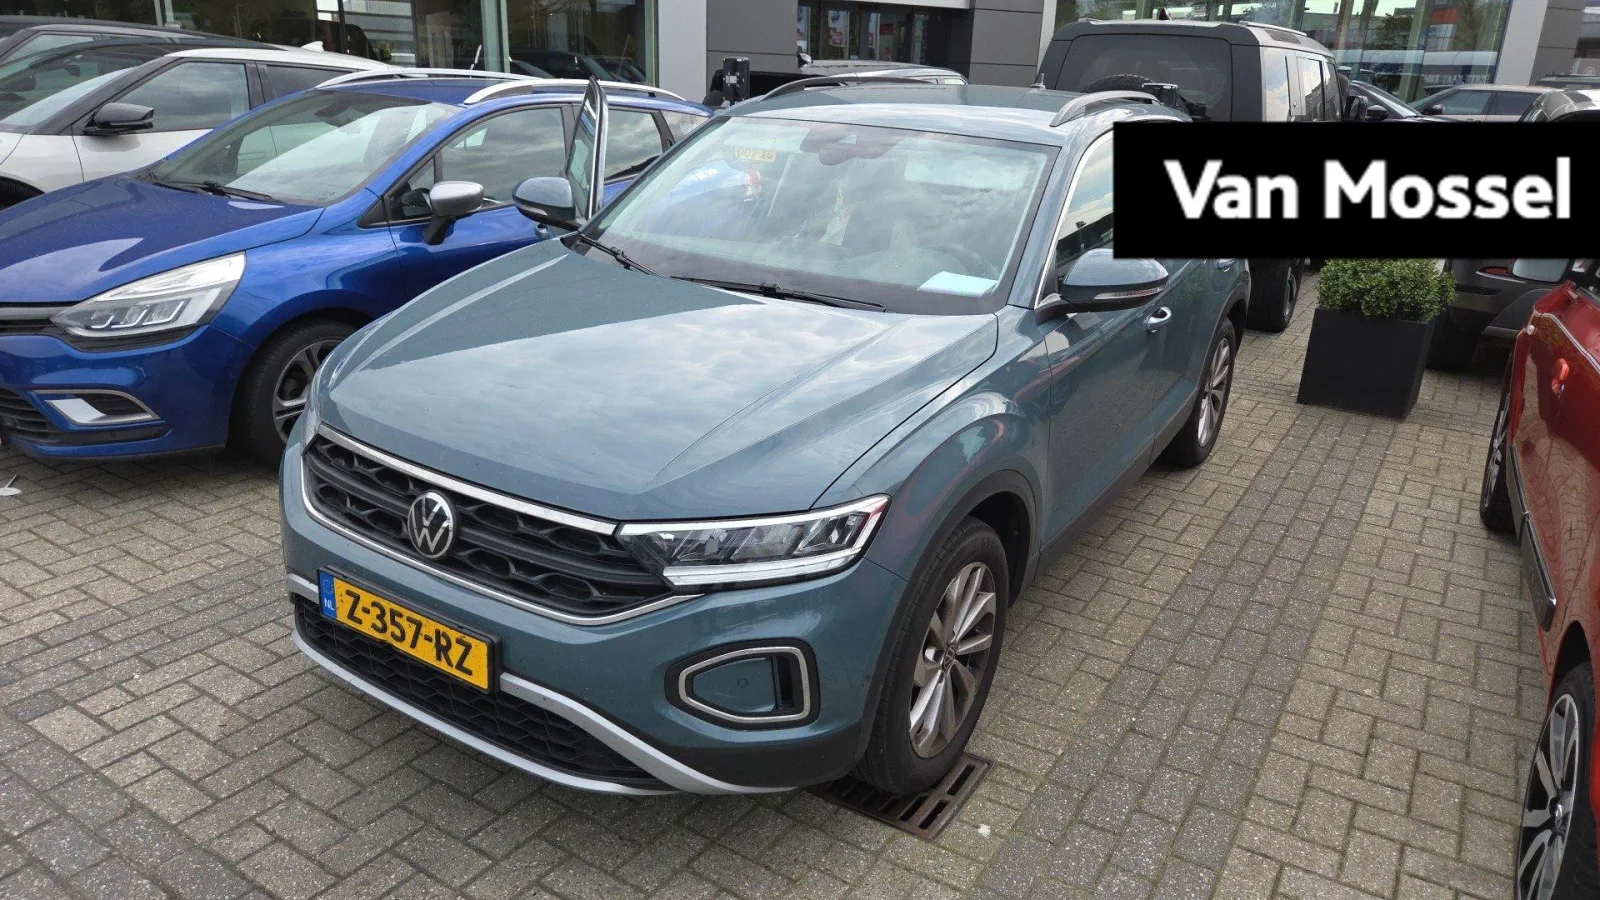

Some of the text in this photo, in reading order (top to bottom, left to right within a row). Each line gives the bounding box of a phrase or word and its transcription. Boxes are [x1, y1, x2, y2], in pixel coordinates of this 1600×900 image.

[409, 492, 453, 558] VW
[323, 597, 335, 611] NL
[345, 589, 473, 676] Z-357-RZ
